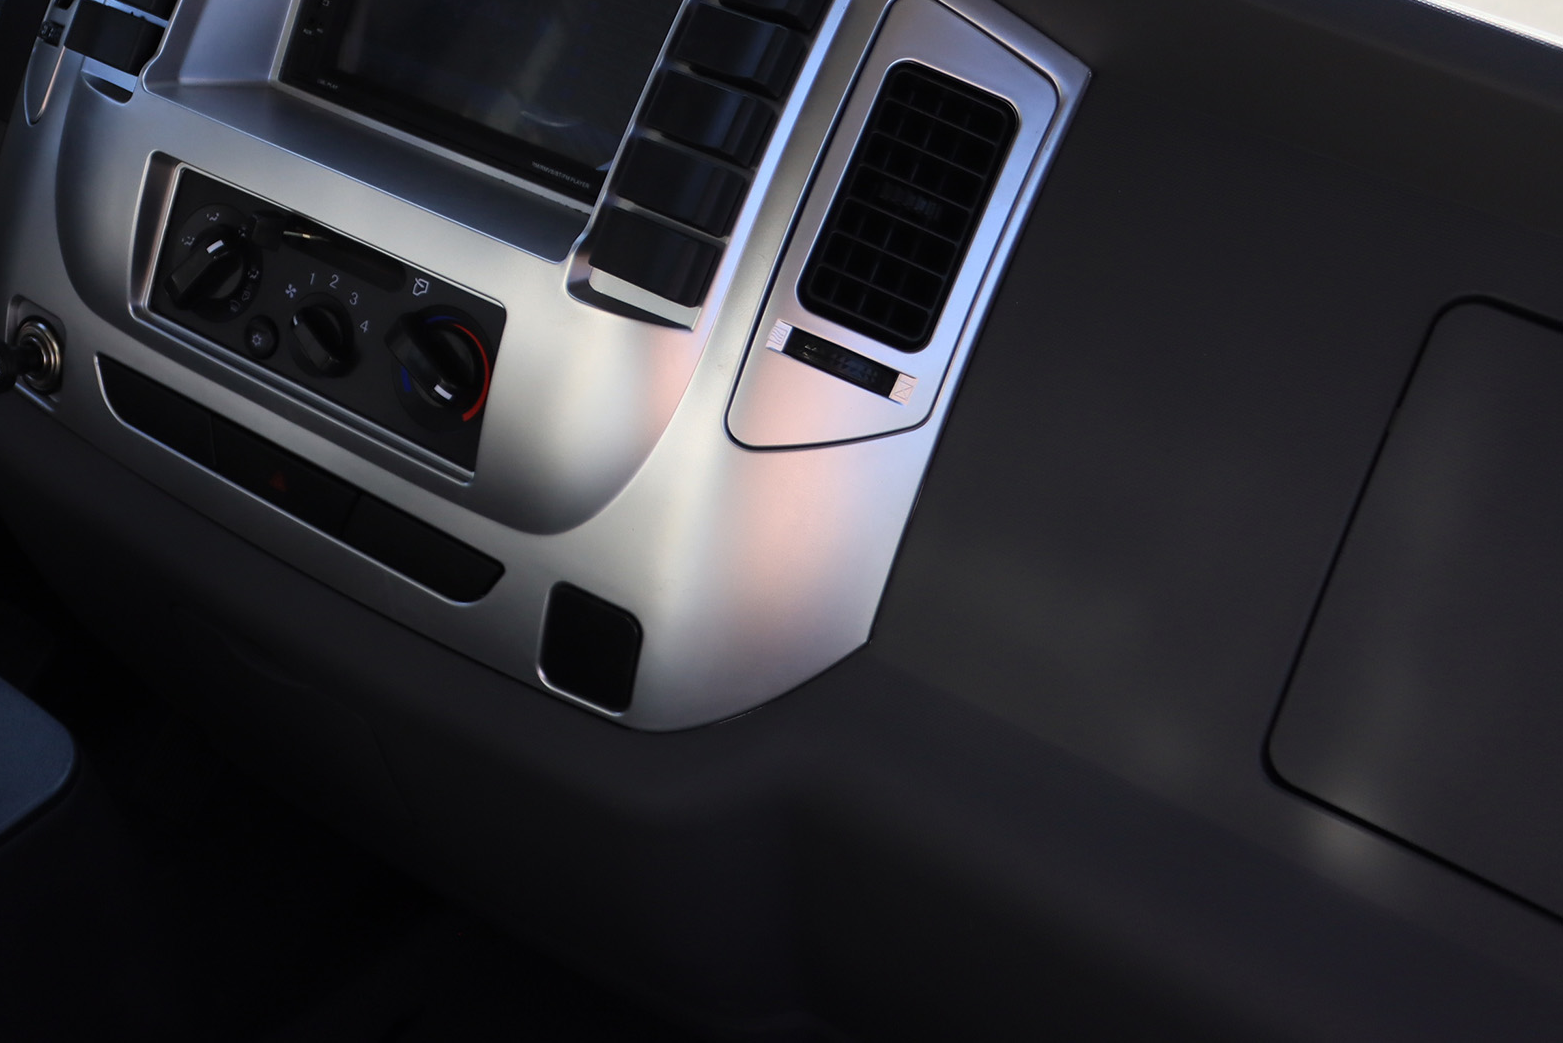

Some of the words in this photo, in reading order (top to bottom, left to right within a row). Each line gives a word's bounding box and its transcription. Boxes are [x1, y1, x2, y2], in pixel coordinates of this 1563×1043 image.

[310, 273, 315, 285] 1
[329, 274, 340, 289] 2
[349, 292, 359, 306] 3
[360, 320, 369, 333] 4
